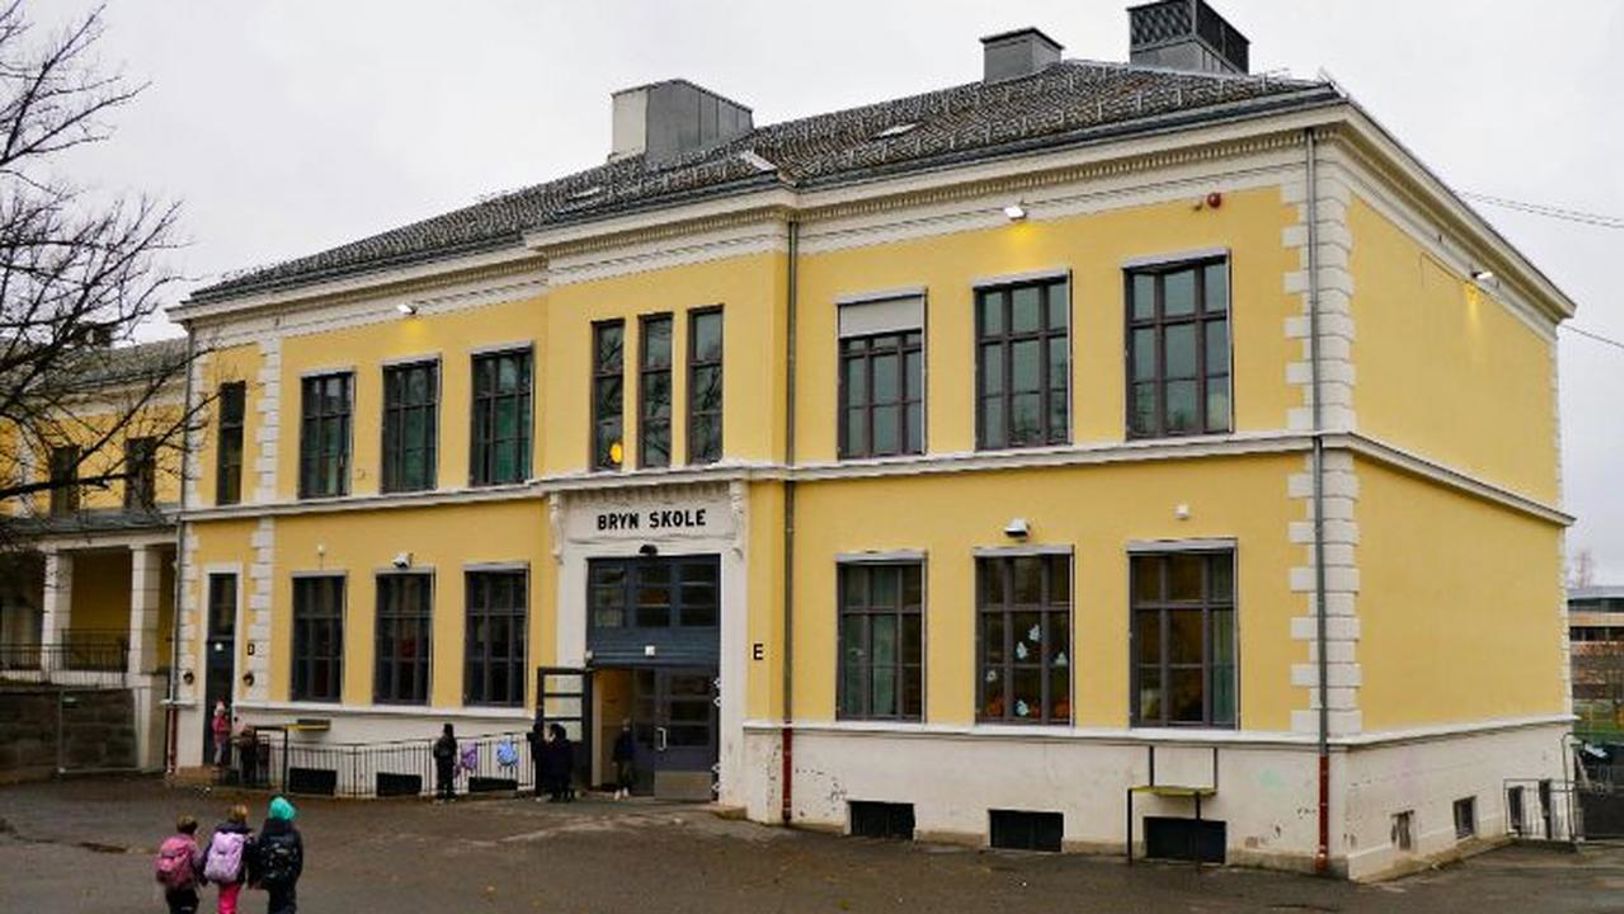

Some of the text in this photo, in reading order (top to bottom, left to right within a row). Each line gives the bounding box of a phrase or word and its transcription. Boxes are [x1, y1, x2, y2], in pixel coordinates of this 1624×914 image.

[597, 508, 706, 531] BRYN SKOLE
[753, 643, 764, 661] E
